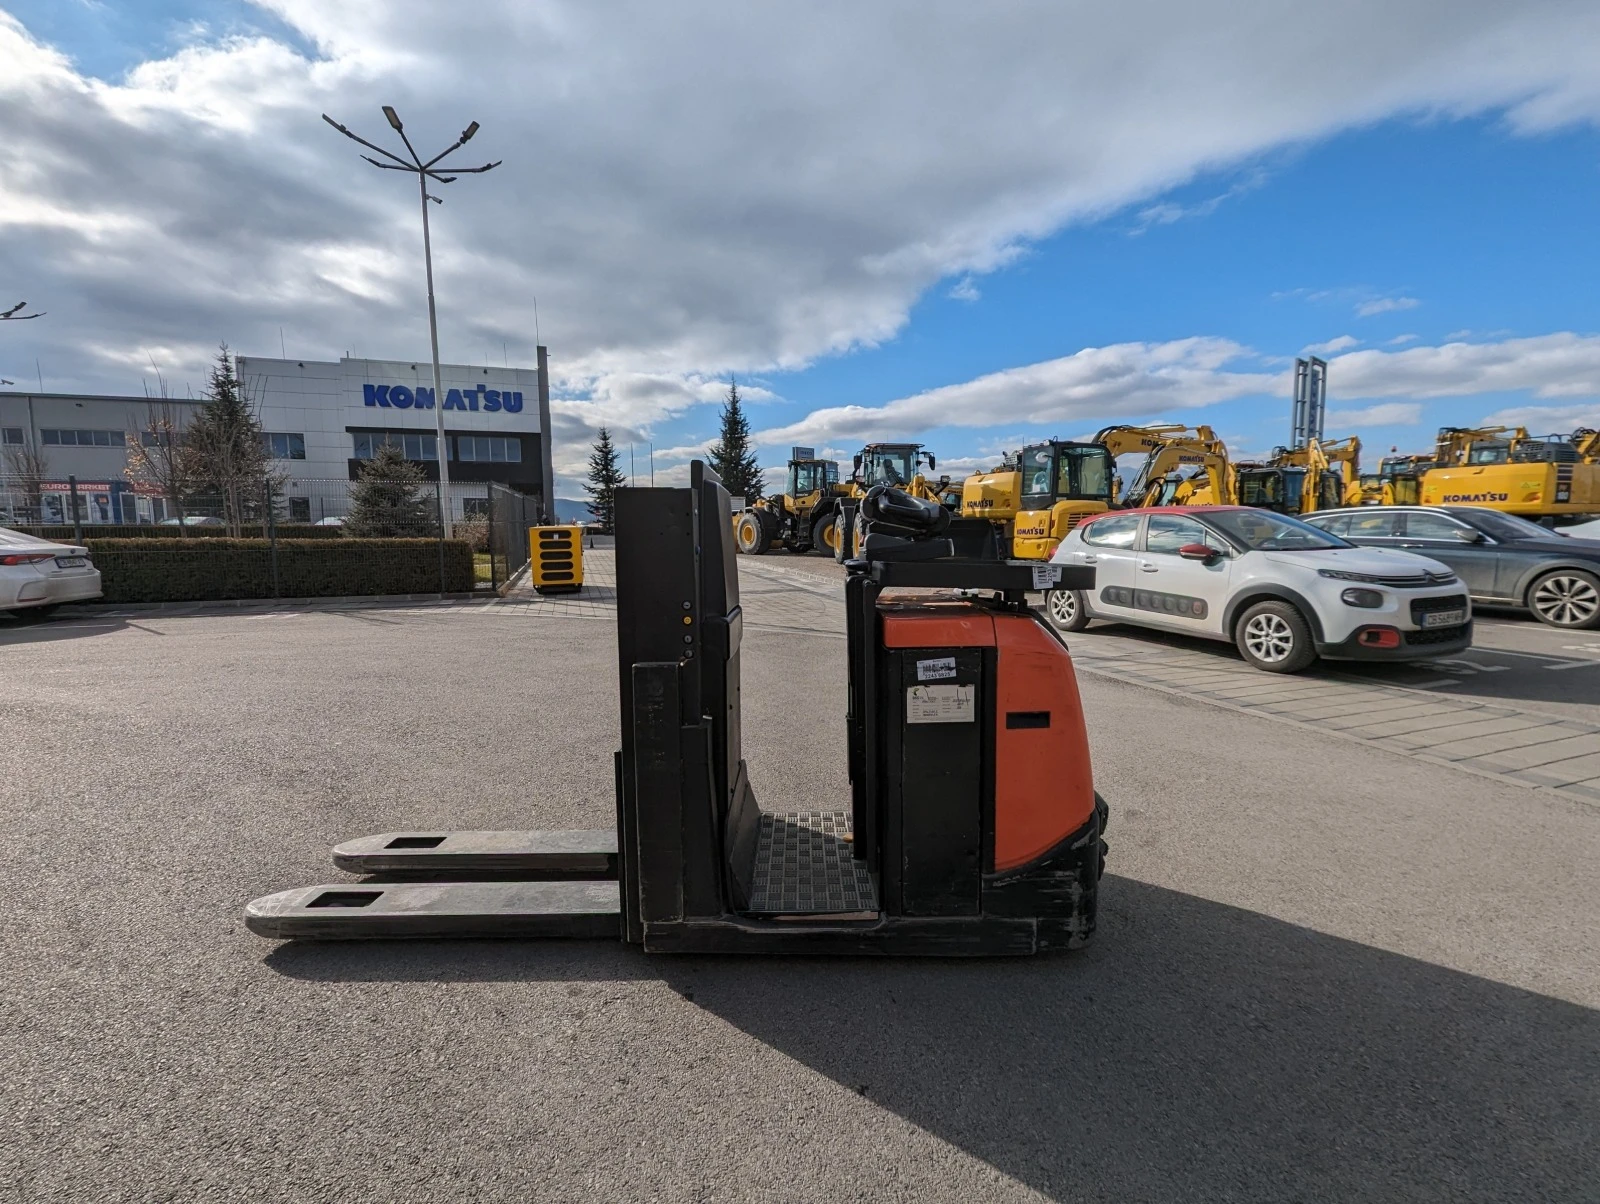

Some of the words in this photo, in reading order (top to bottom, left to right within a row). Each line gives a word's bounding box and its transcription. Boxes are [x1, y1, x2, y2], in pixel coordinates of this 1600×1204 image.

[363, 383, 523, 413] KOMATSU
[41, 483, 110, 491] EUROARKET
[1443, 491, 1508, 503] KOMATSU
[967, 498, 994, 508] KOMATSU
[1017, 527, 1044, 535] KOMATSU
